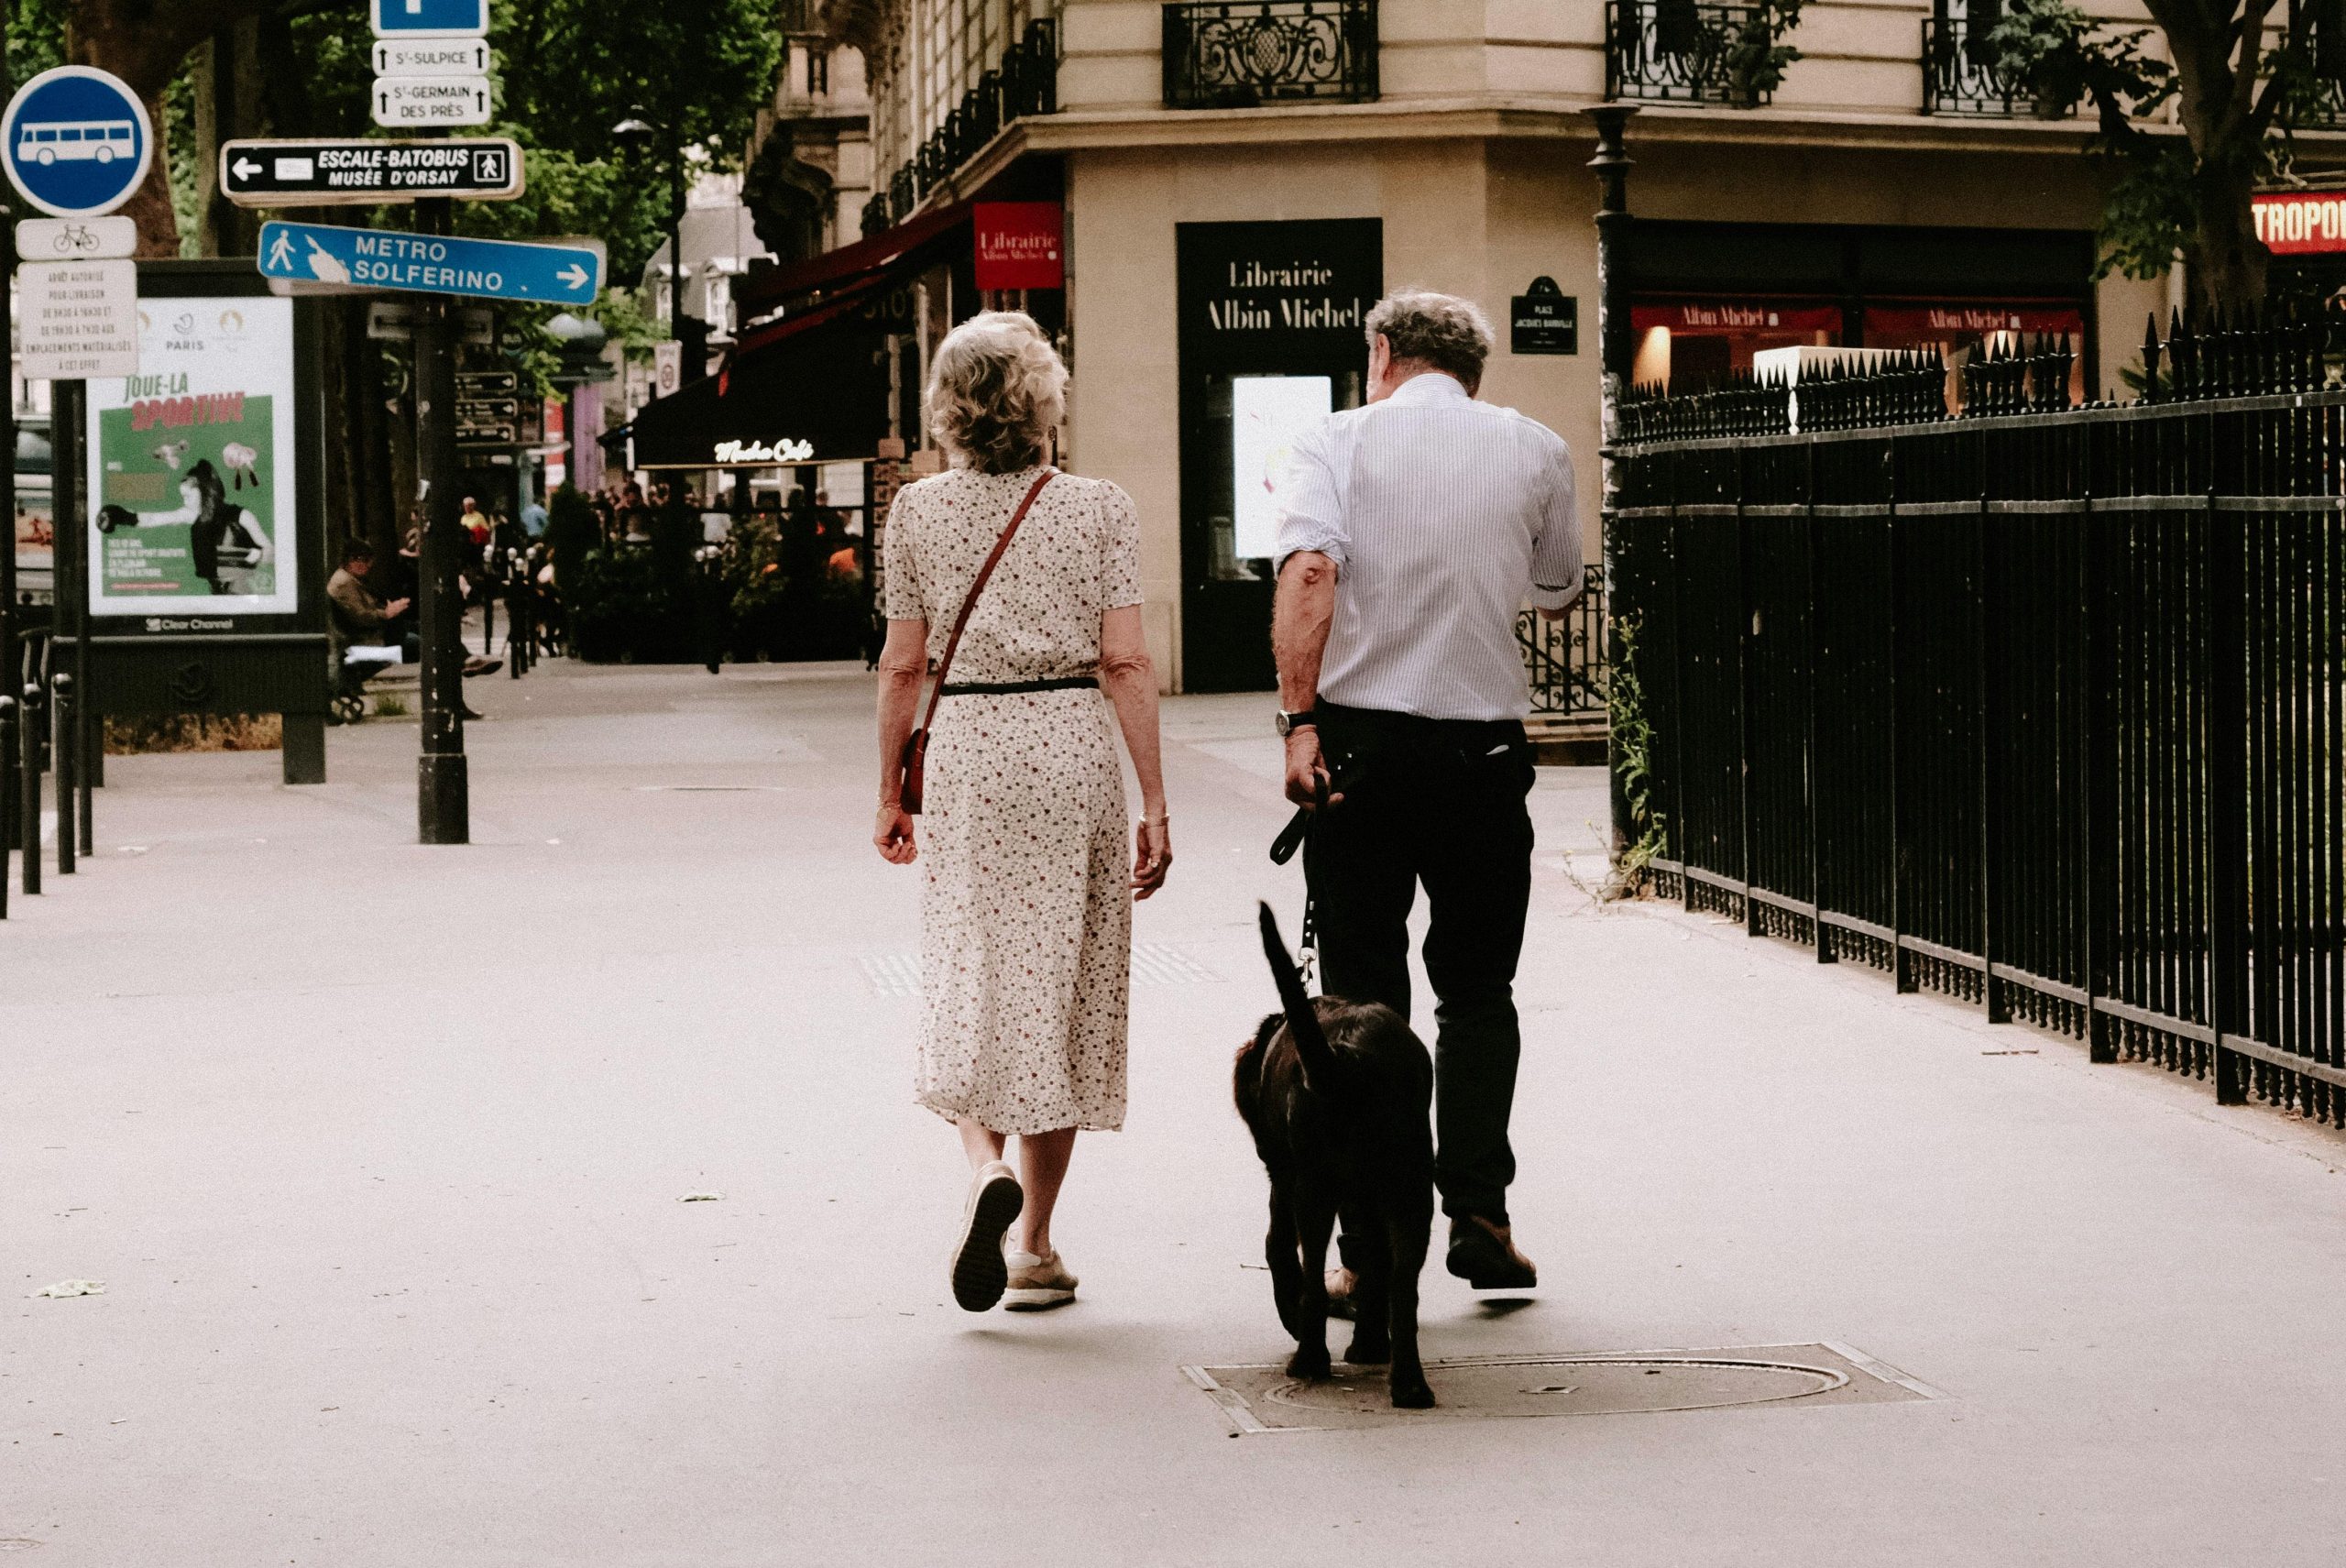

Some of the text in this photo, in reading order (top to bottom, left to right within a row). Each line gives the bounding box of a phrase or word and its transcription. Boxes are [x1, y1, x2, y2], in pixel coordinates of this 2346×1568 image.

[400, 105, 425, 117] DES
[318, 149, 469, 169] ESCALE-BATOBUS
[328, 168, 459, 186] MUSÉE D'ORSAY
[356, 236, 446, 263] METRO
[981, 231, 1057, 248] Librairie
[354, 259, 503, 291] SOLFERINO
[1230, 260, 1332, 287] Librairie
[1209, 297, 1359, 330] Albin Michel
[1683, 305, 1764, 325] Albin Michel
[1930, 310, 2005, 328] Albin Michel
[167, 341, 203, 351] PARIS
[125, 372, 188, 402] JOUE-LA
